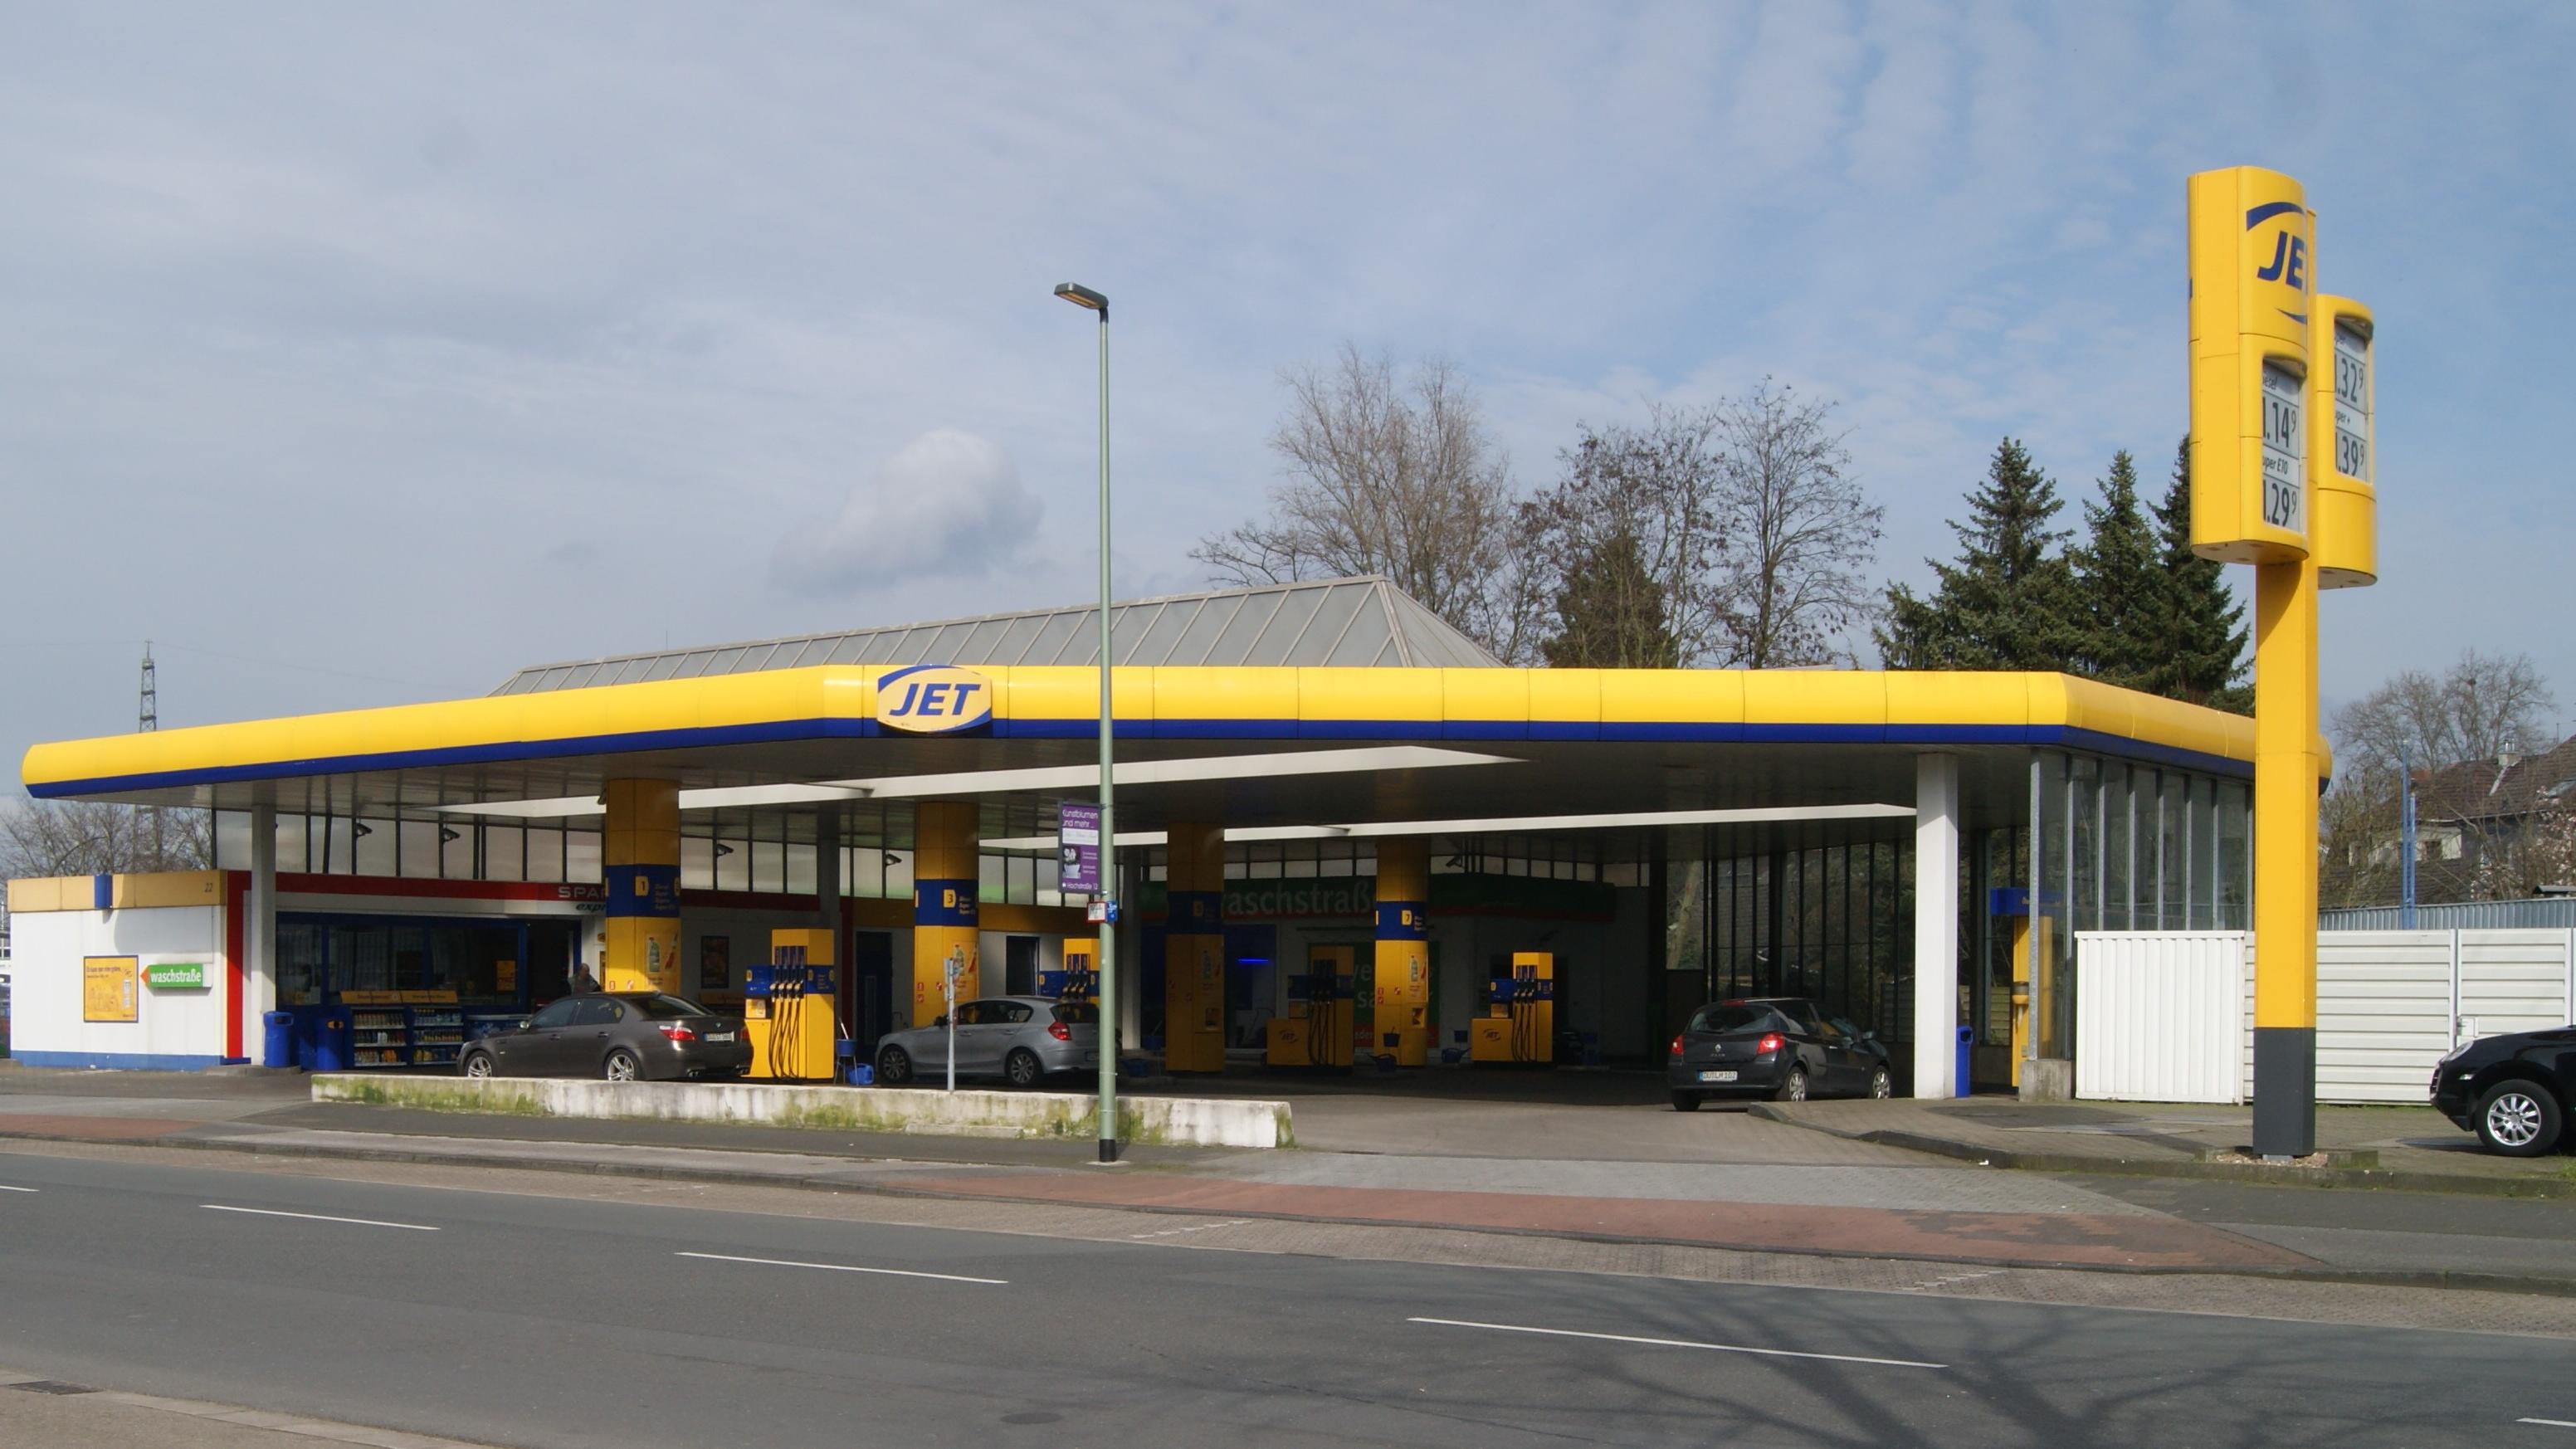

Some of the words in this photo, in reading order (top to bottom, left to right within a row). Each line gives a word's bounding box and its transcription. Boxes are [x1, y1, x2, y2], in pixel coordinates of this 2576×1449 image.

[2257, 230, 2306, 292] JE
[888, 683, 982, 717] JET
[150, 968, 202, 983] waschstraße
